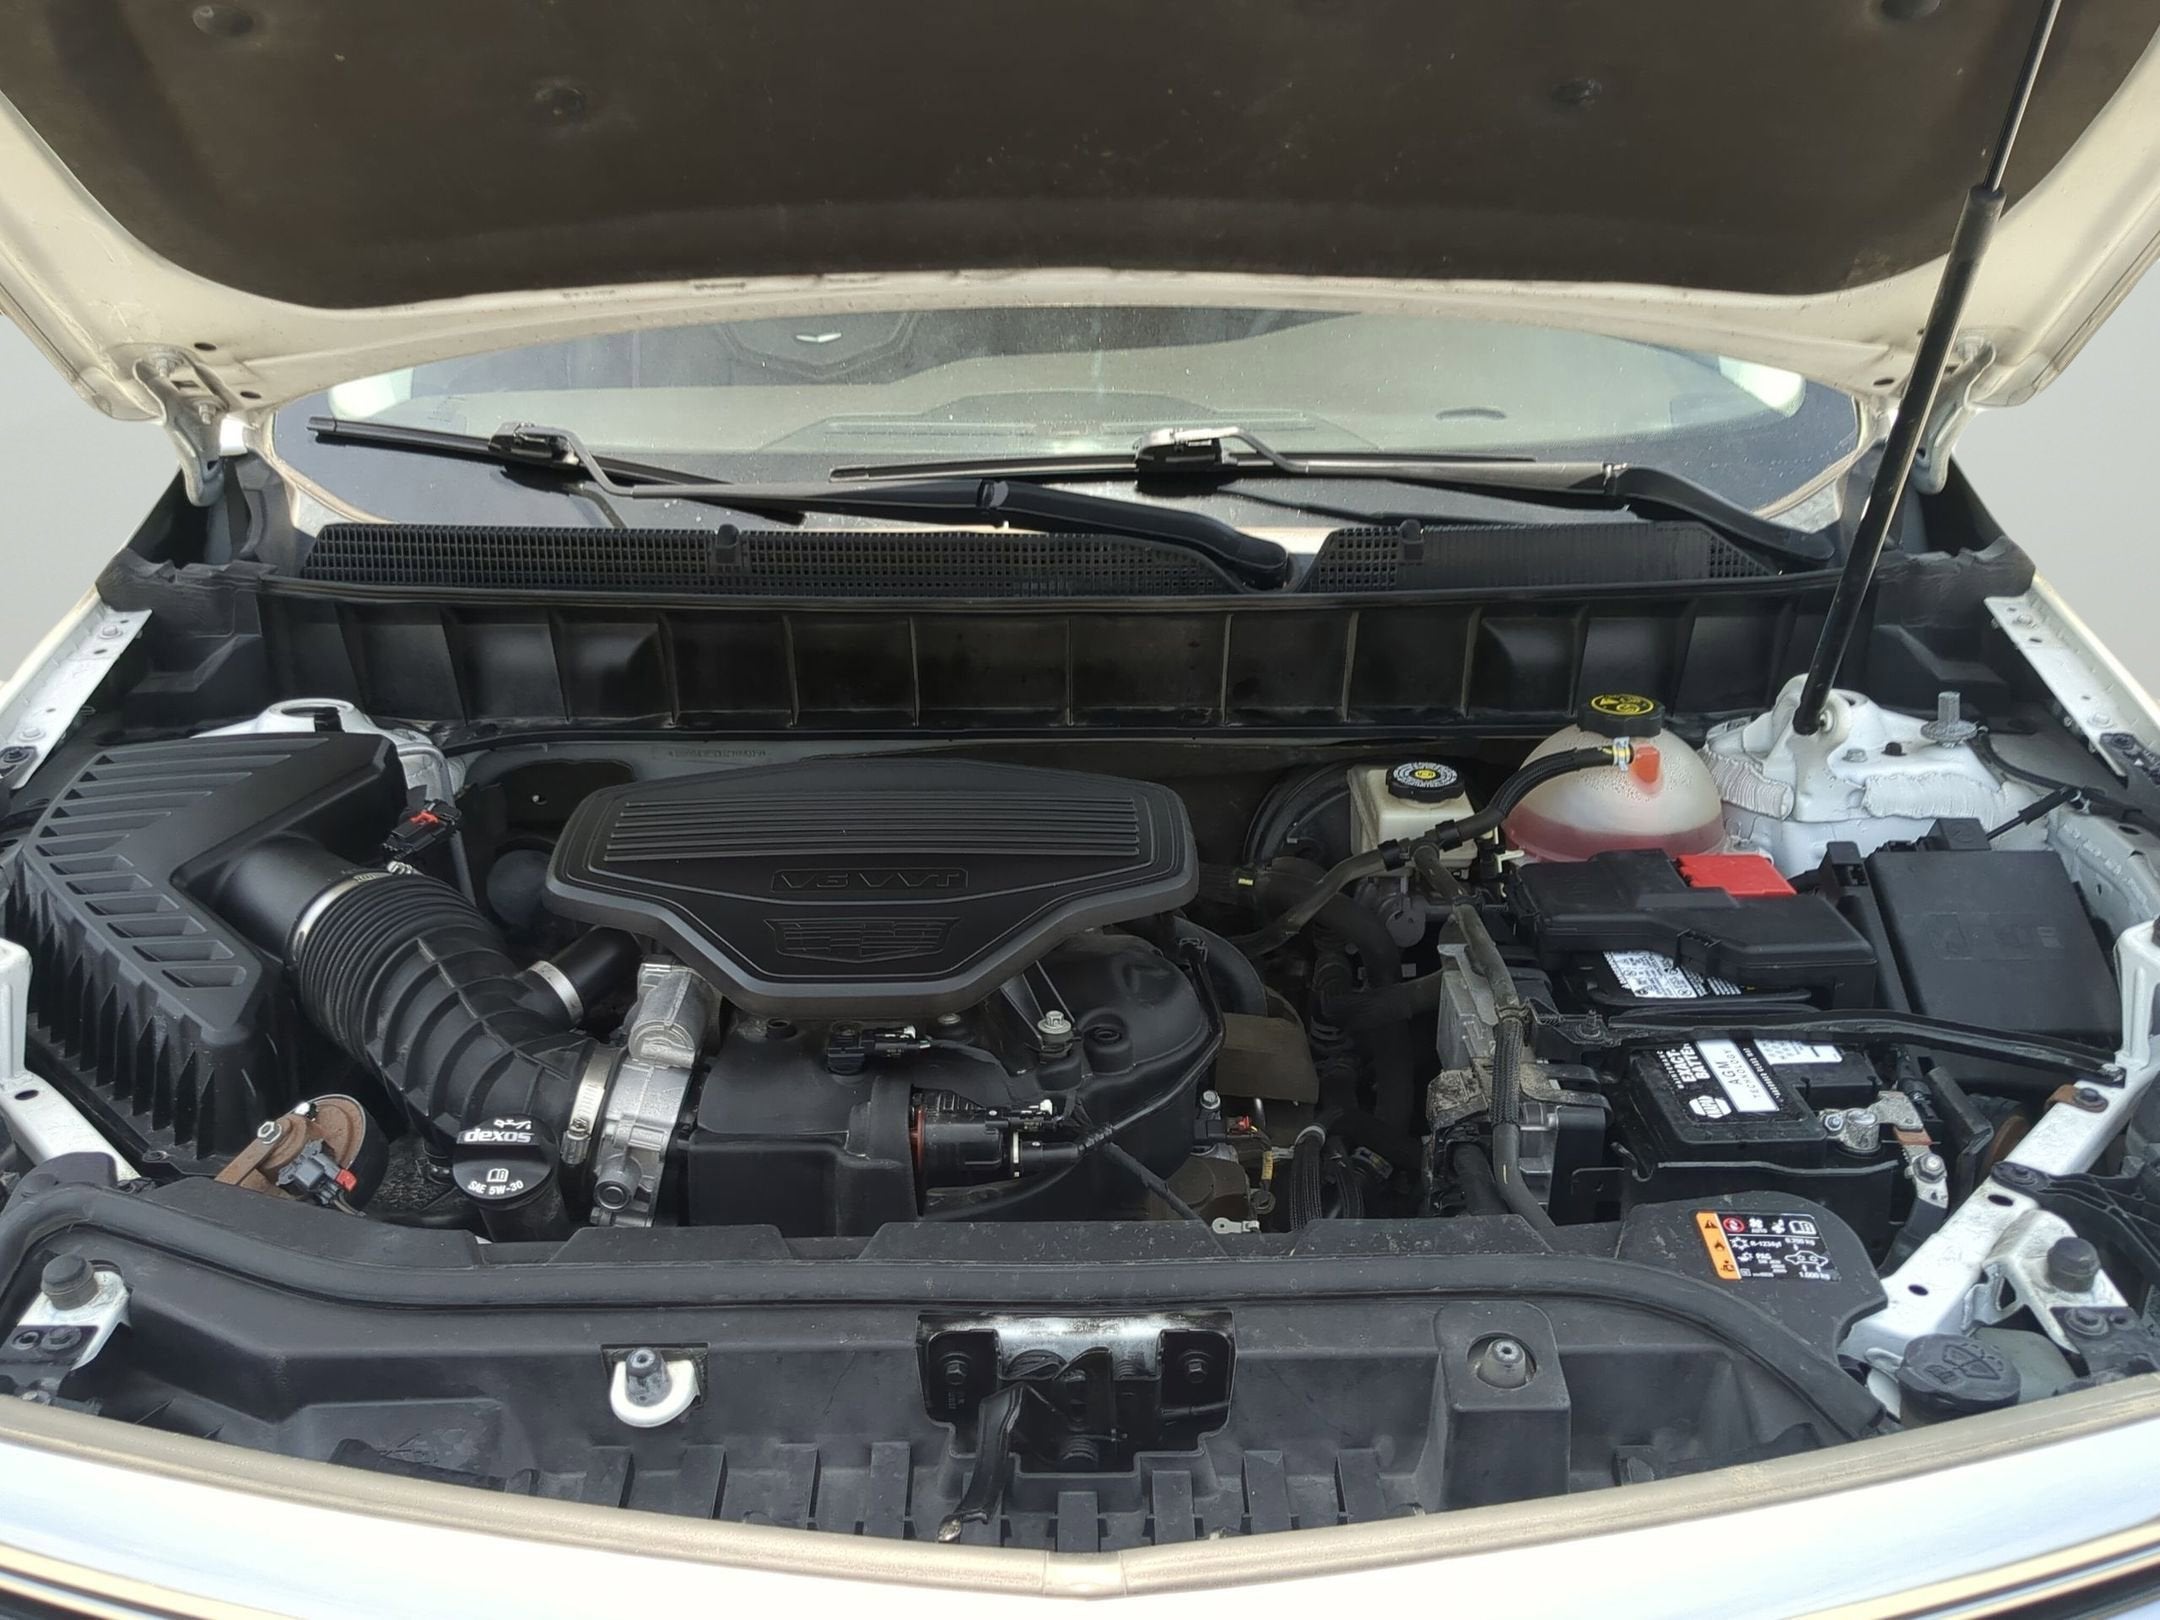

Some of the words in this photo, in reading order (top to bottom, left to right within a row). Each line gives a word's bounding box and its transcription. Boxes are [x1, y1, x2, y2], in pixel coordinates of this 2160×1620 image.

[1656, 1050, 1685, 1090] MAINTENANC
[1715, 1060, 1743, 1086] AGM
[1723, 1049, 1762, 1099] TECHNOLOGY
[464, 1128, 535, 1143] dexos
[468, 1180, 487, 1195] SAE
[488, 1180, 524, 1195] 5W-30
